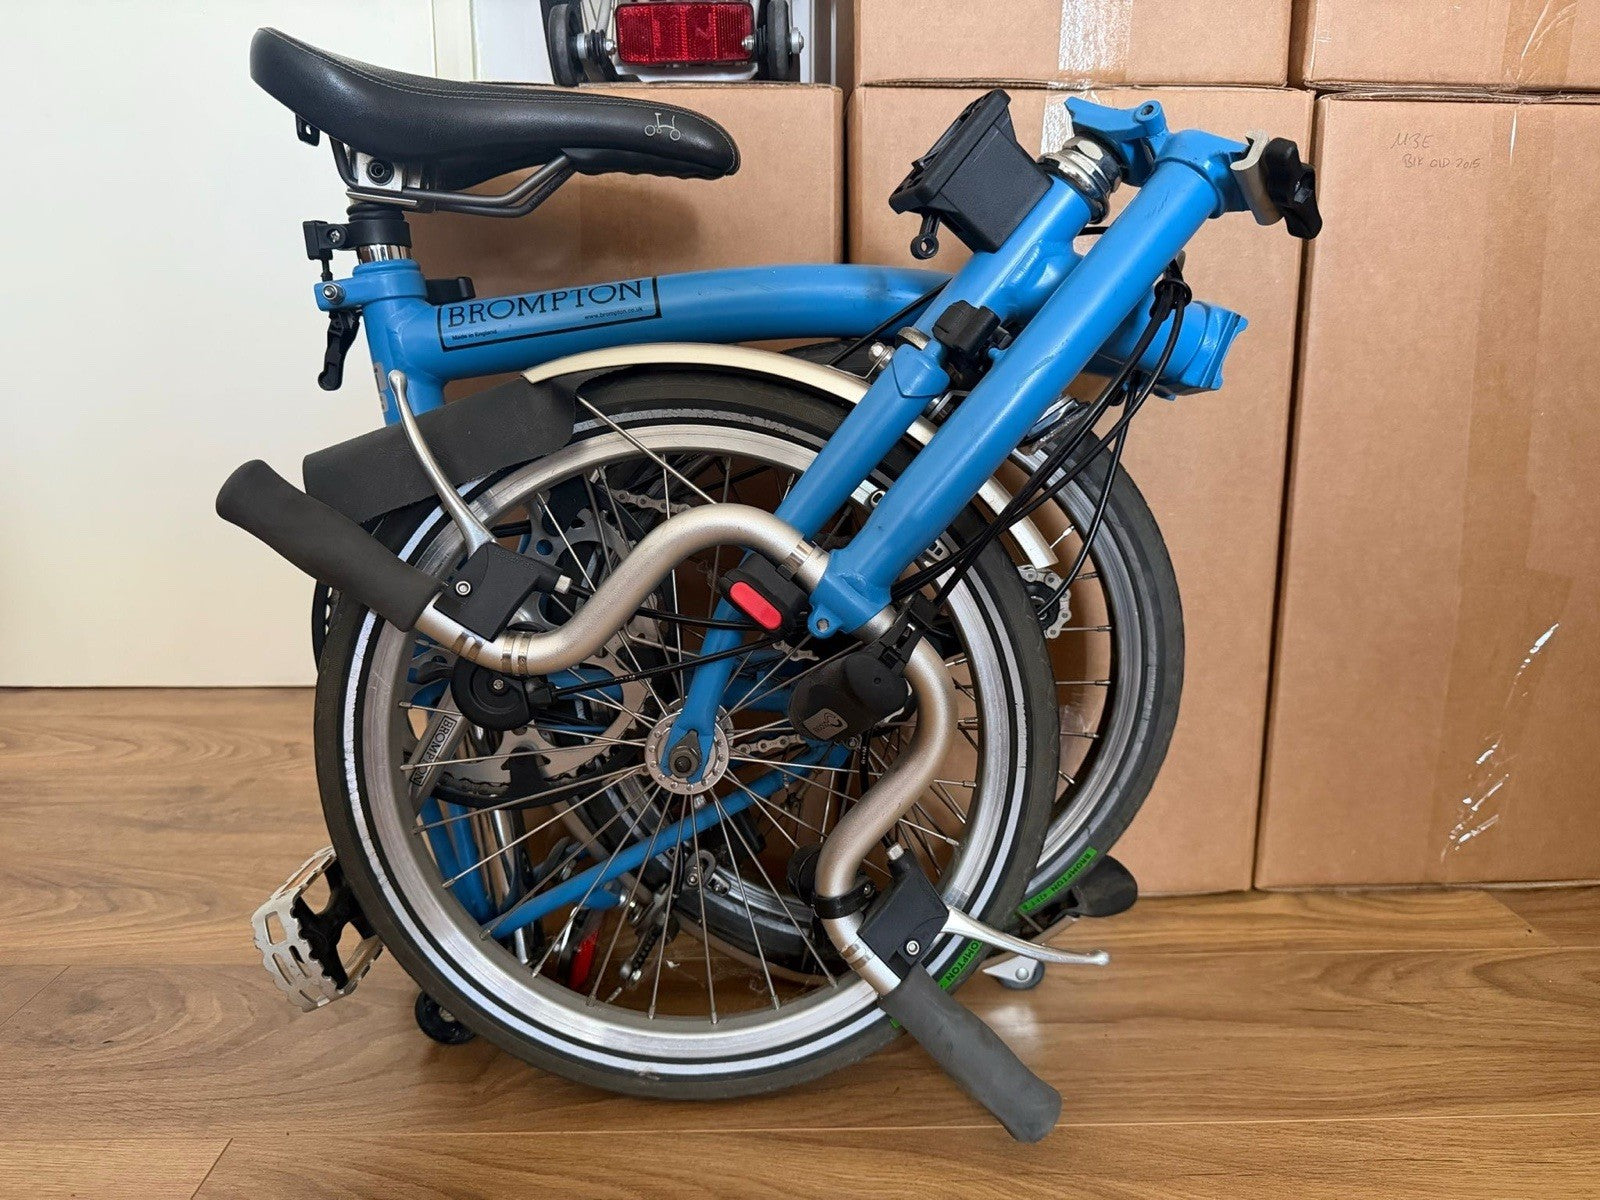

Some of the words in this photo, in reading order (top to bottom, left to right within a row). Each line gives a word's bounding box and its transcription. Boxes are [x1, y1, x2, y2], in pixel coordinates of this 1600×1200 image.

[448, 280, 643, 327] BROMPTON
[475, 329, 498, 337] England
[1050, 853, 1091, 892] BROMPTON
[945, 942, 979, 981] OMPTON
